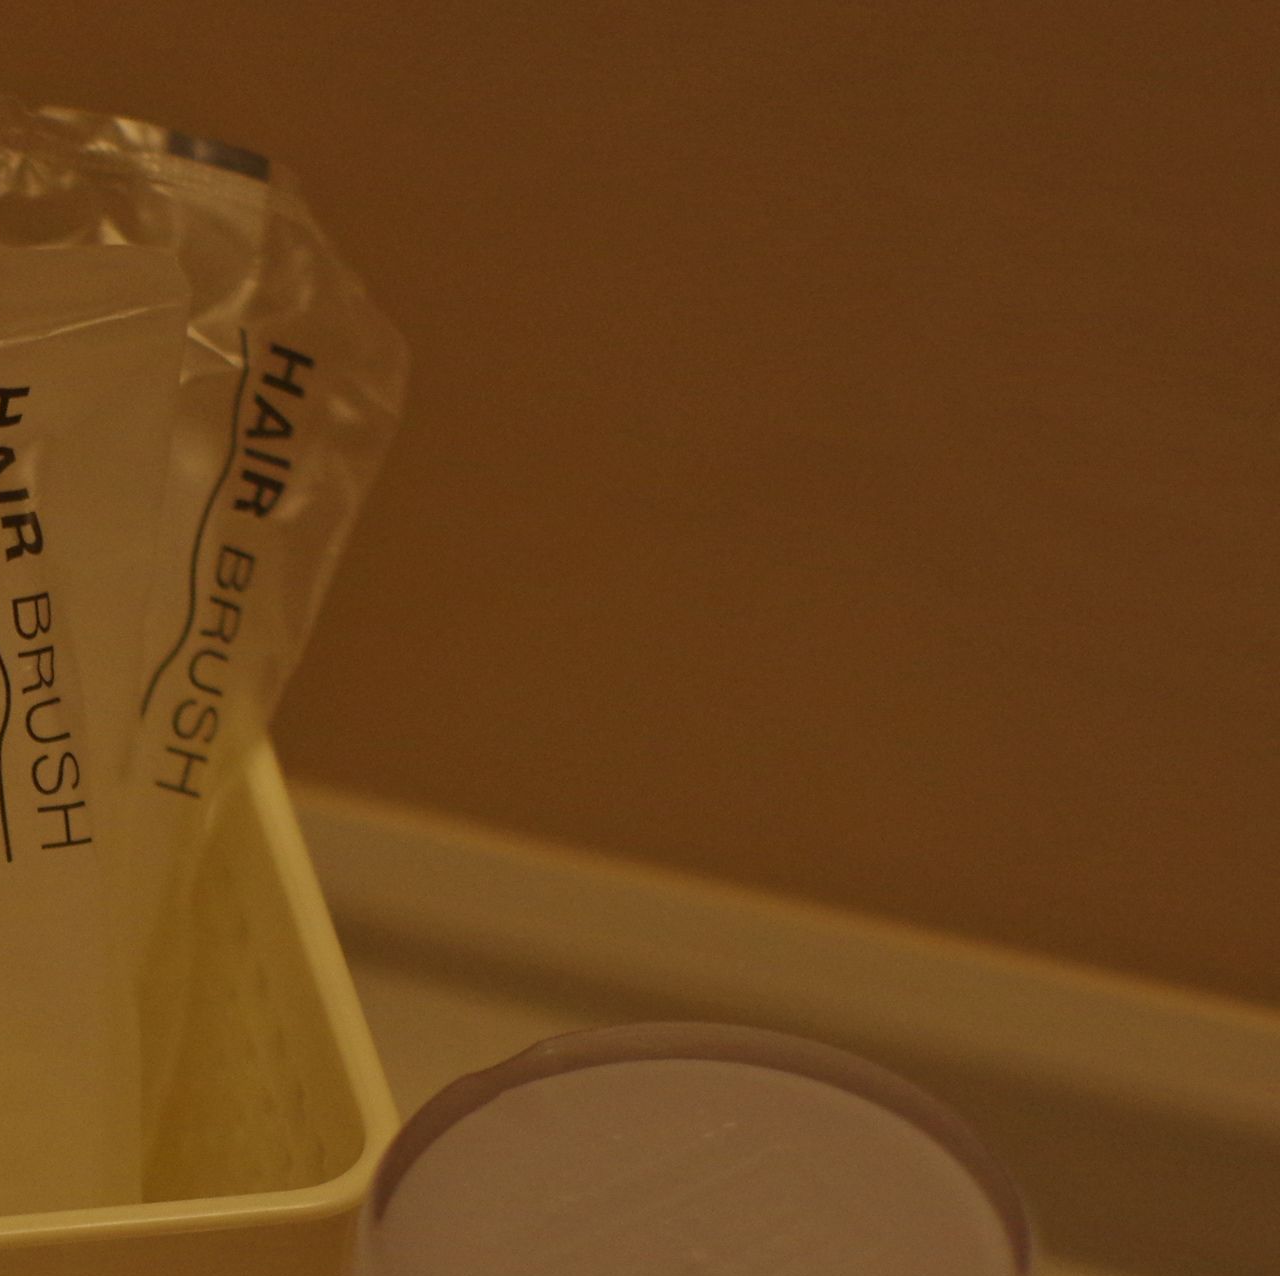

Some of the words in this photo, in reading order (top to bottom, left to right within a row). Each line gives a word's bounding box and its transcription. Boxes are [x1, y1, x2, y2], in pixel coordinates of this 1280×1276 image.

[232, 342, 315, 519] HAIR
[11, 592, 93, 850] BRUSH
[154, 543, 255, 799] BRUSH
